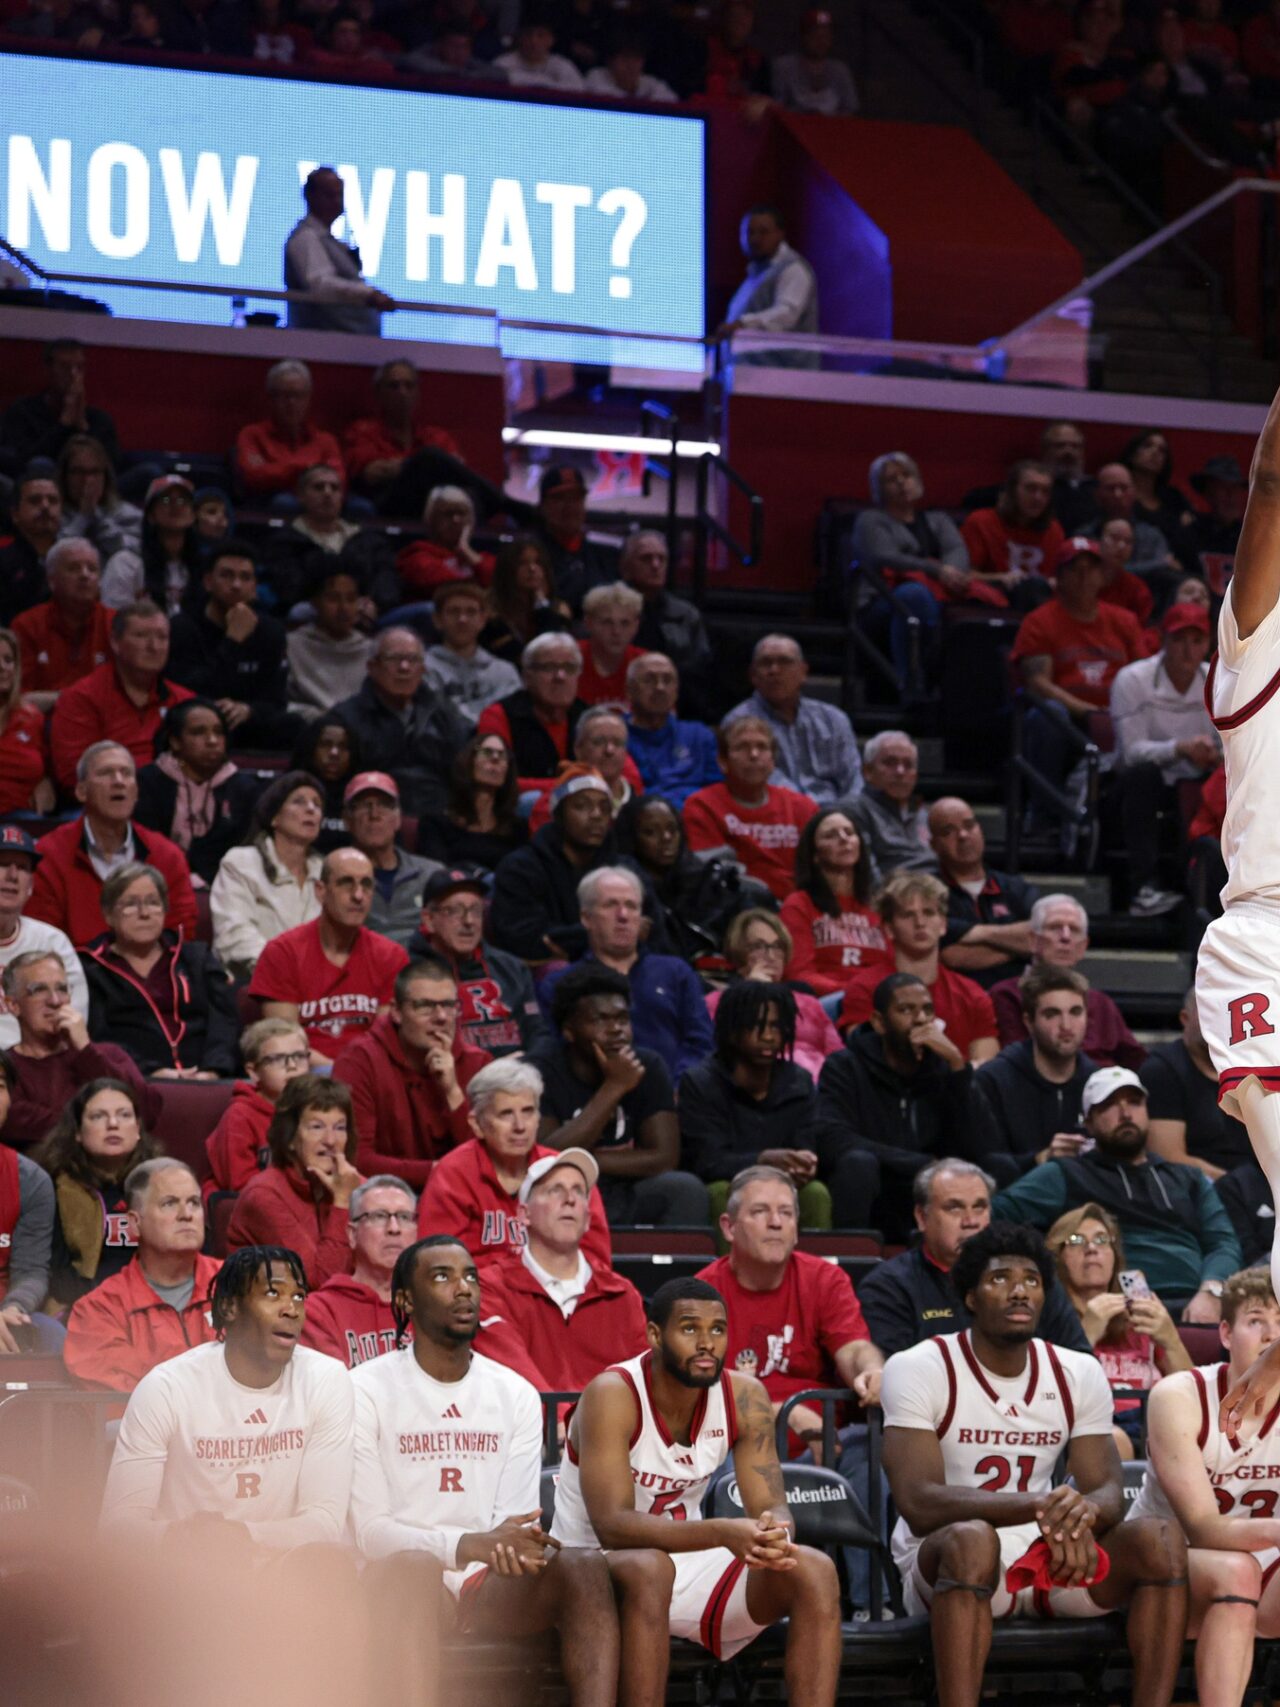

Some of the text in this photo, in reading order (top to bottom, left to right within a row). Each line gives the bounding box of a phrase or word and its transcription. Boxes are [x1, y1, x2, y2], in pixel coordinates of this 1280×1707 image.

[7, 134, 649, 299] NOW WHAT?
[842, 946, 863, 967] R
[300, 993, 379, 1019] UTGERS
[459, 977, 513, 1022] R
[1227, 992, 1276, 1047] R
[106, 1212, 140, 1247] R
[196, 1430, 304, 1460] SCARLET KNIGHTS
[399, 1433, 498, 1454] SCARLET KNIGHTS
[958, 1428, 1062, 1446] RUTGERS
[236, 1472, 262, 1499] R
[439, 1467, 465, 1493] R
[974, 1455, 1037, 1493] 21
